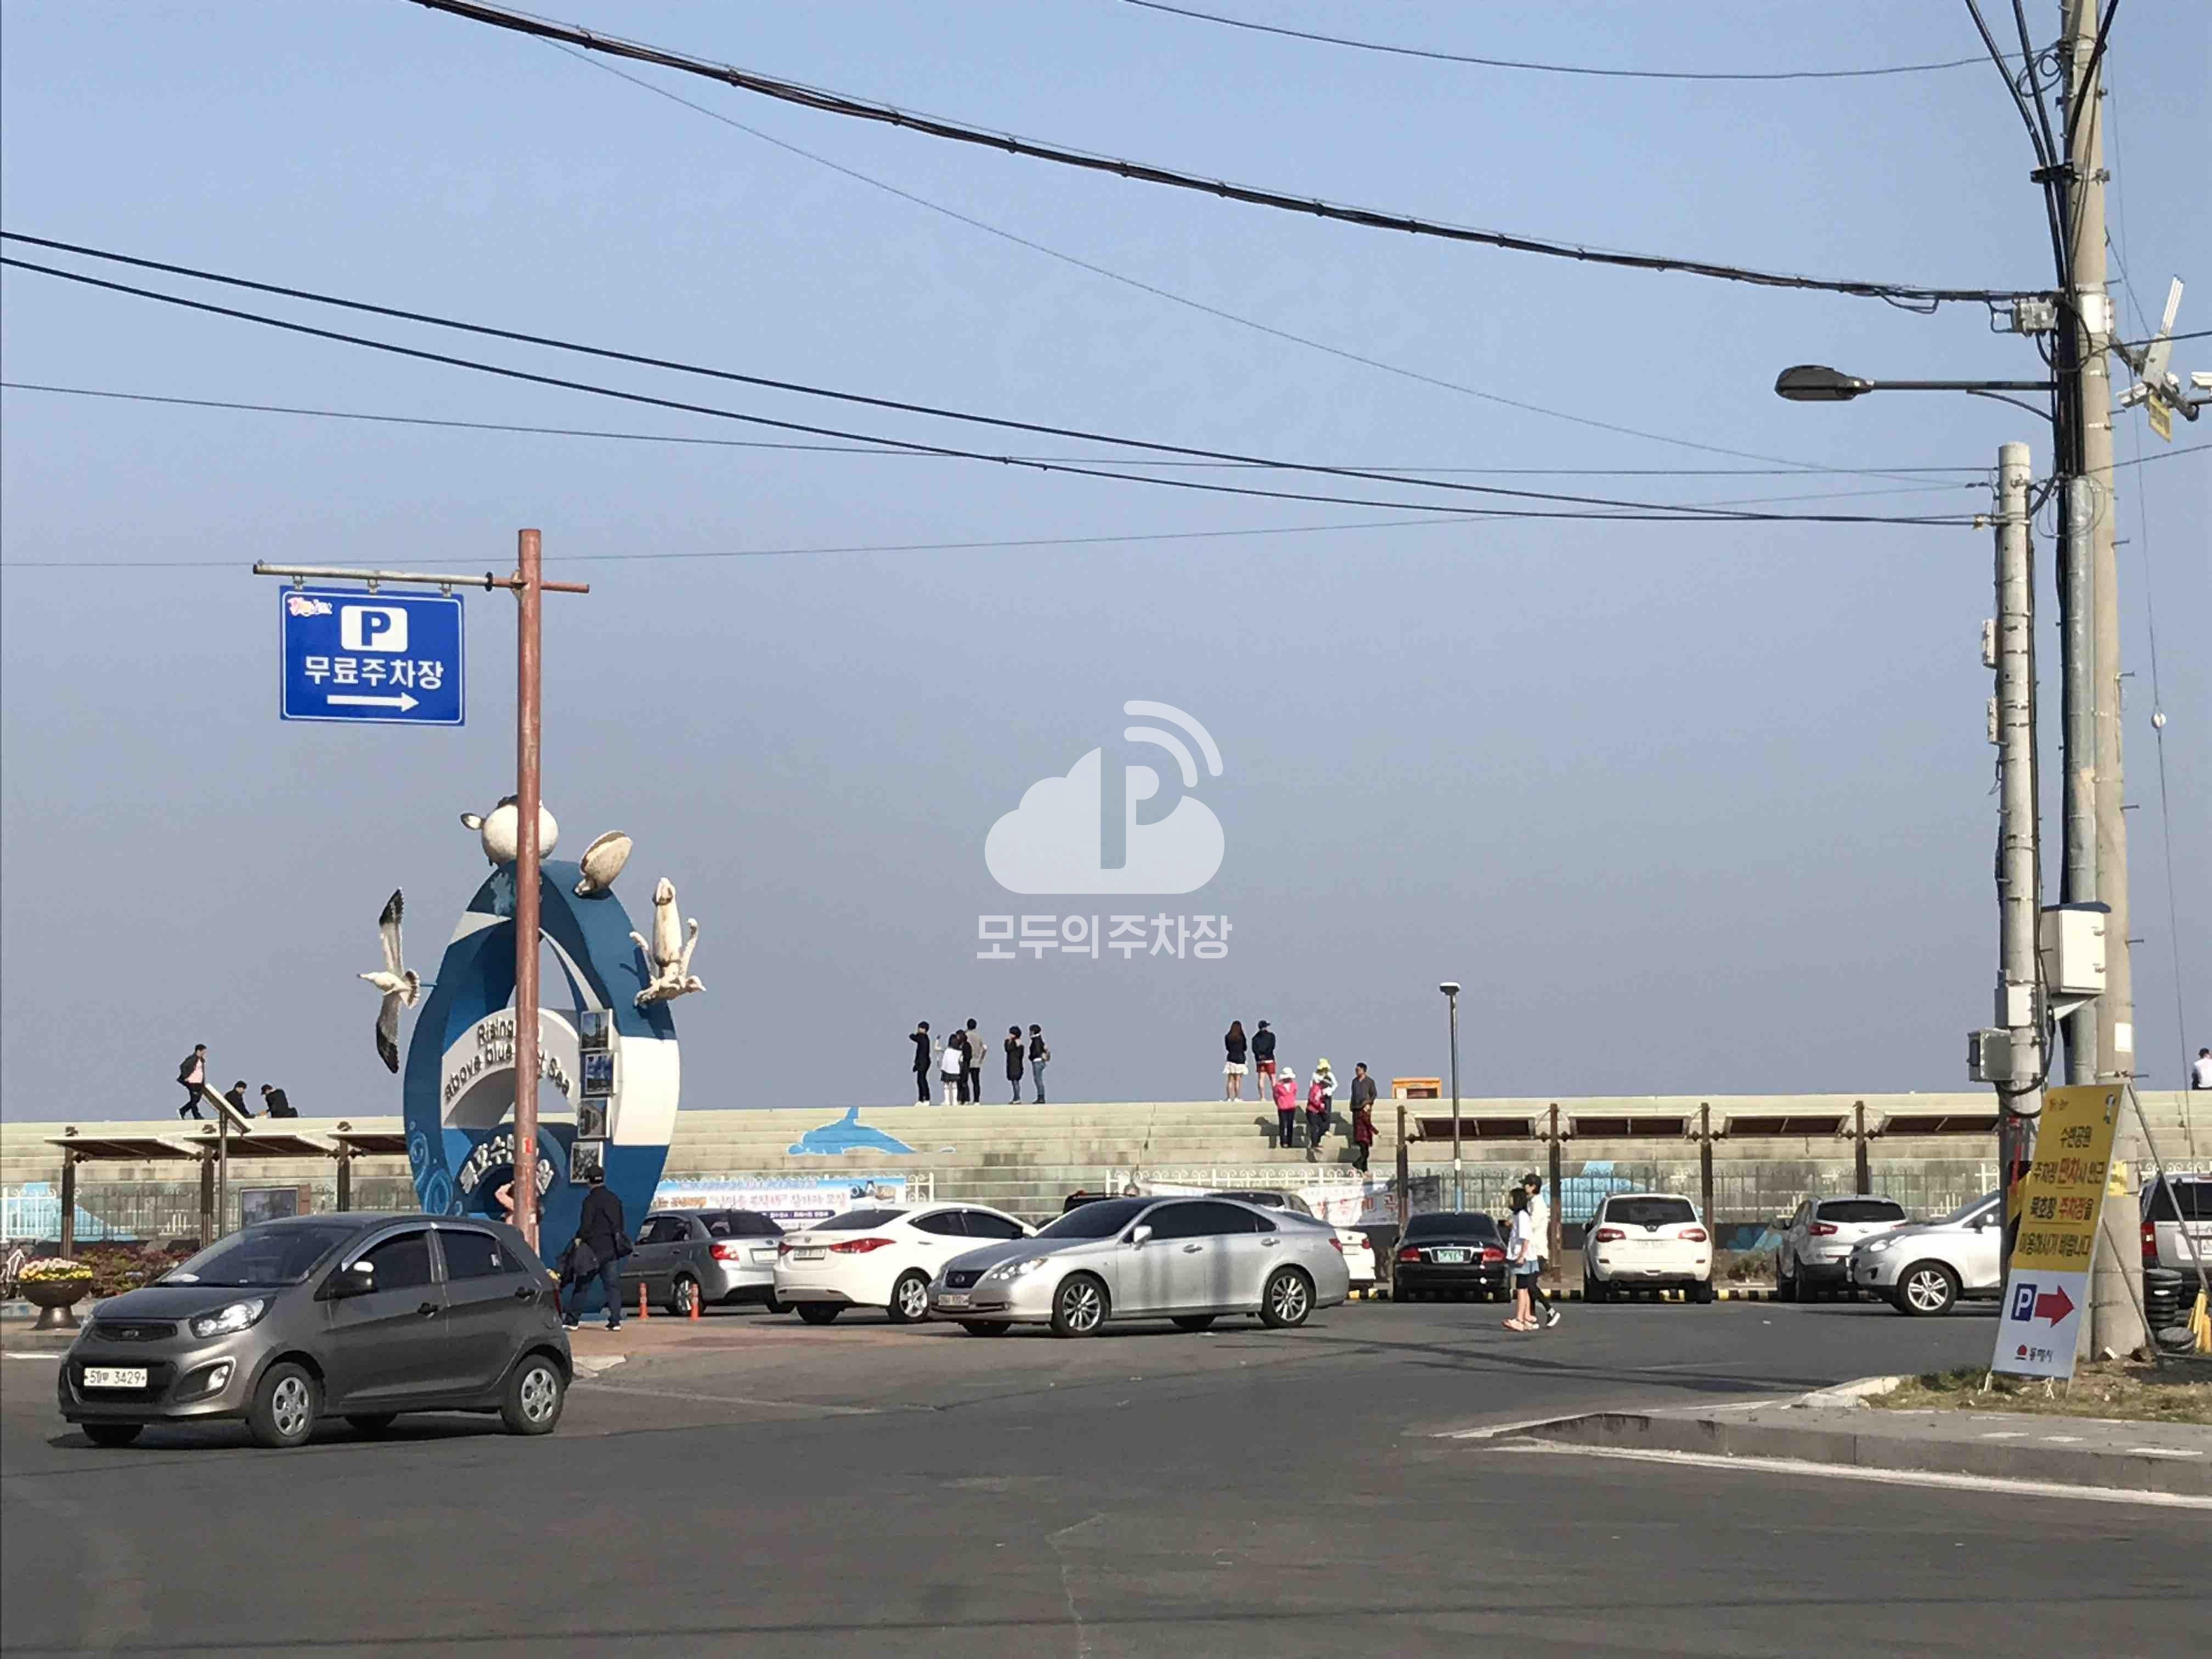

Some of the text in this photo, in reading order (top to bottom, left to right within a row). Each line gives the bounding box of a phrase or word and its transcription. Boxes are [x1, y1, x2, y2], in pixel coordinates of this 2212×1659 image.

[361, 611, 391, 646] P
[305, 656, 444, 690] 무료주차장
[476, 1018, 514, 1047] Rising
[445, 1054, 483, 1101] above
[485, 1041, 514, 1066] blue
[548, 1057, 570, 1097] Sea
[2015, 1288, 2033, 1317] P
[114, 1371, 141, 1384] 3429
